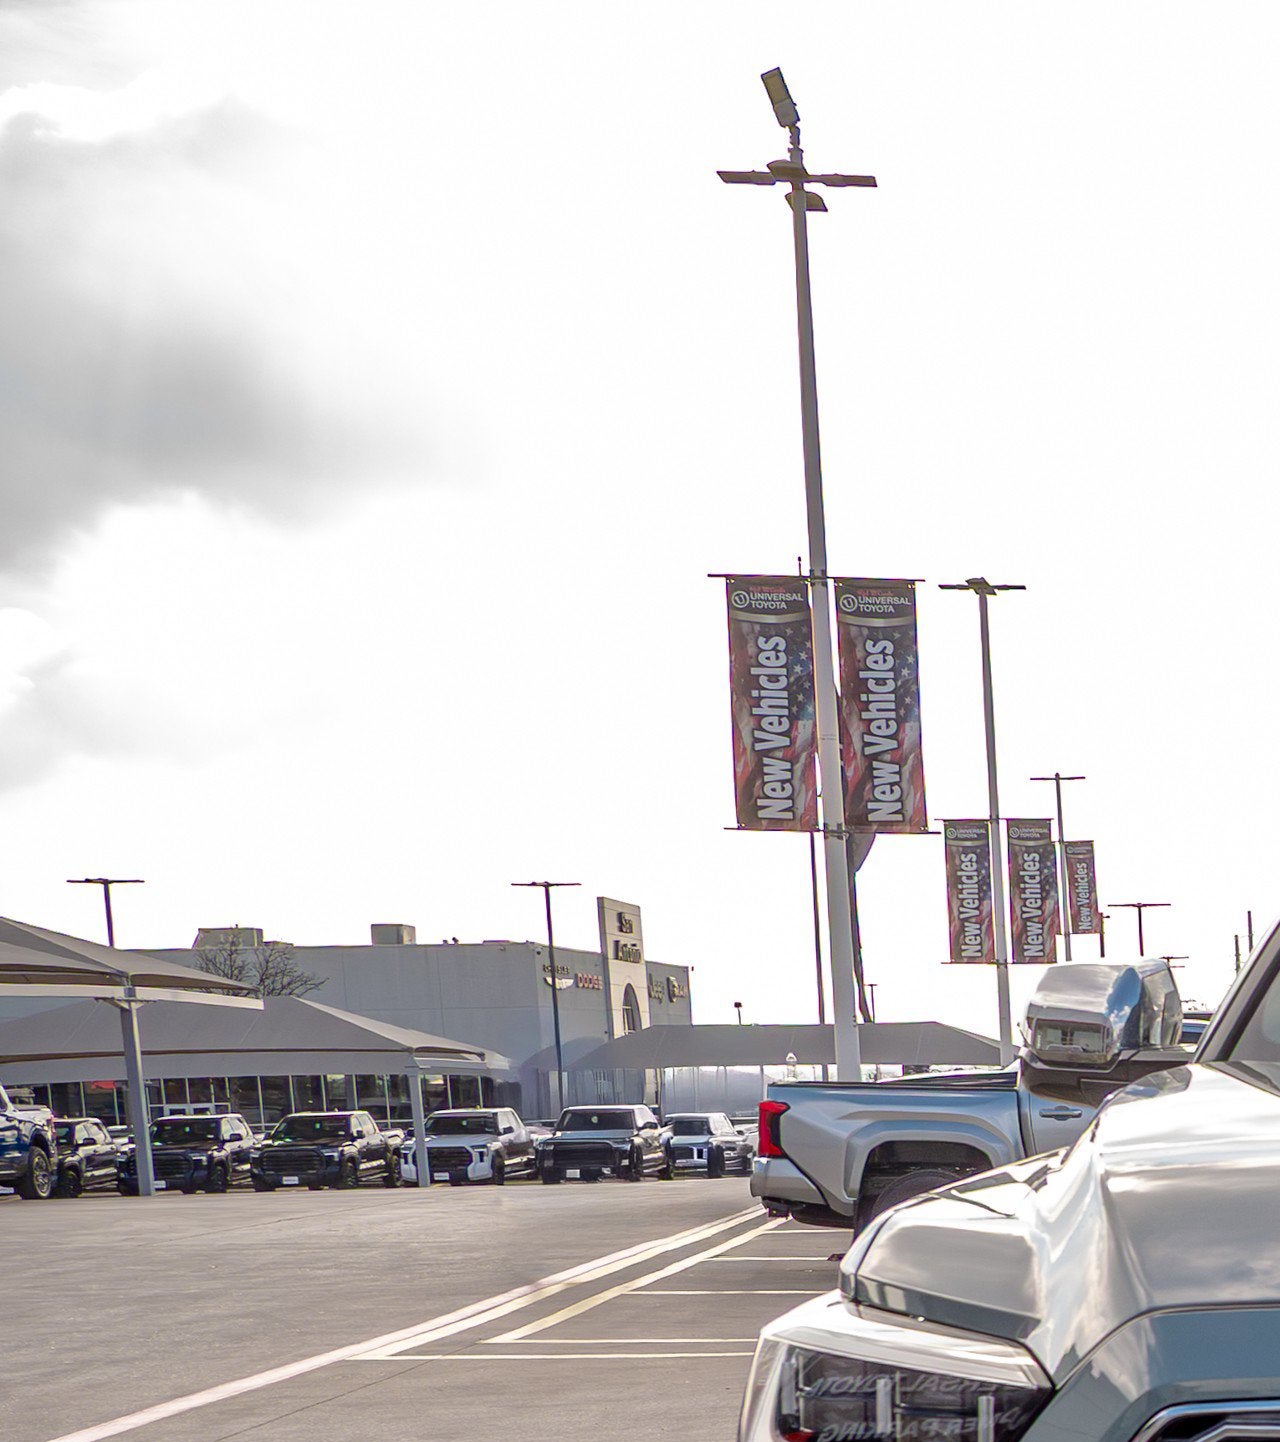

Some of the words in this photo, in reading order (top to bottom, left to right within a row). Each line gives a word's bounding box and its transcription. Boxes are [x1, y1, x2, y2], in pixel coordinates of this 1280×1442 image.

[750, 592, 804, 601] UNIVERSAL
[750, 600, 787, 609] TOYOTA
[858, 596, 912, 605] UNIVERSAL
[859, 604, 895, 613] TOYOTA
[751, 635, 791, 751] Vehicles
[859, 639, 898, 756] Vehicles
[757, 757, 794, 820] New
[866, 761, 904, 822] New
[957, 852, 980, 919] Vehicles
[1020, 852, 1043, 919] Vehicles
[1074, 862, 1090, 905] Vehicles
[1079, 907, 1092, 930] New
[961, 921, 982, 957] New
[1024, 921, 1044, 957] New
